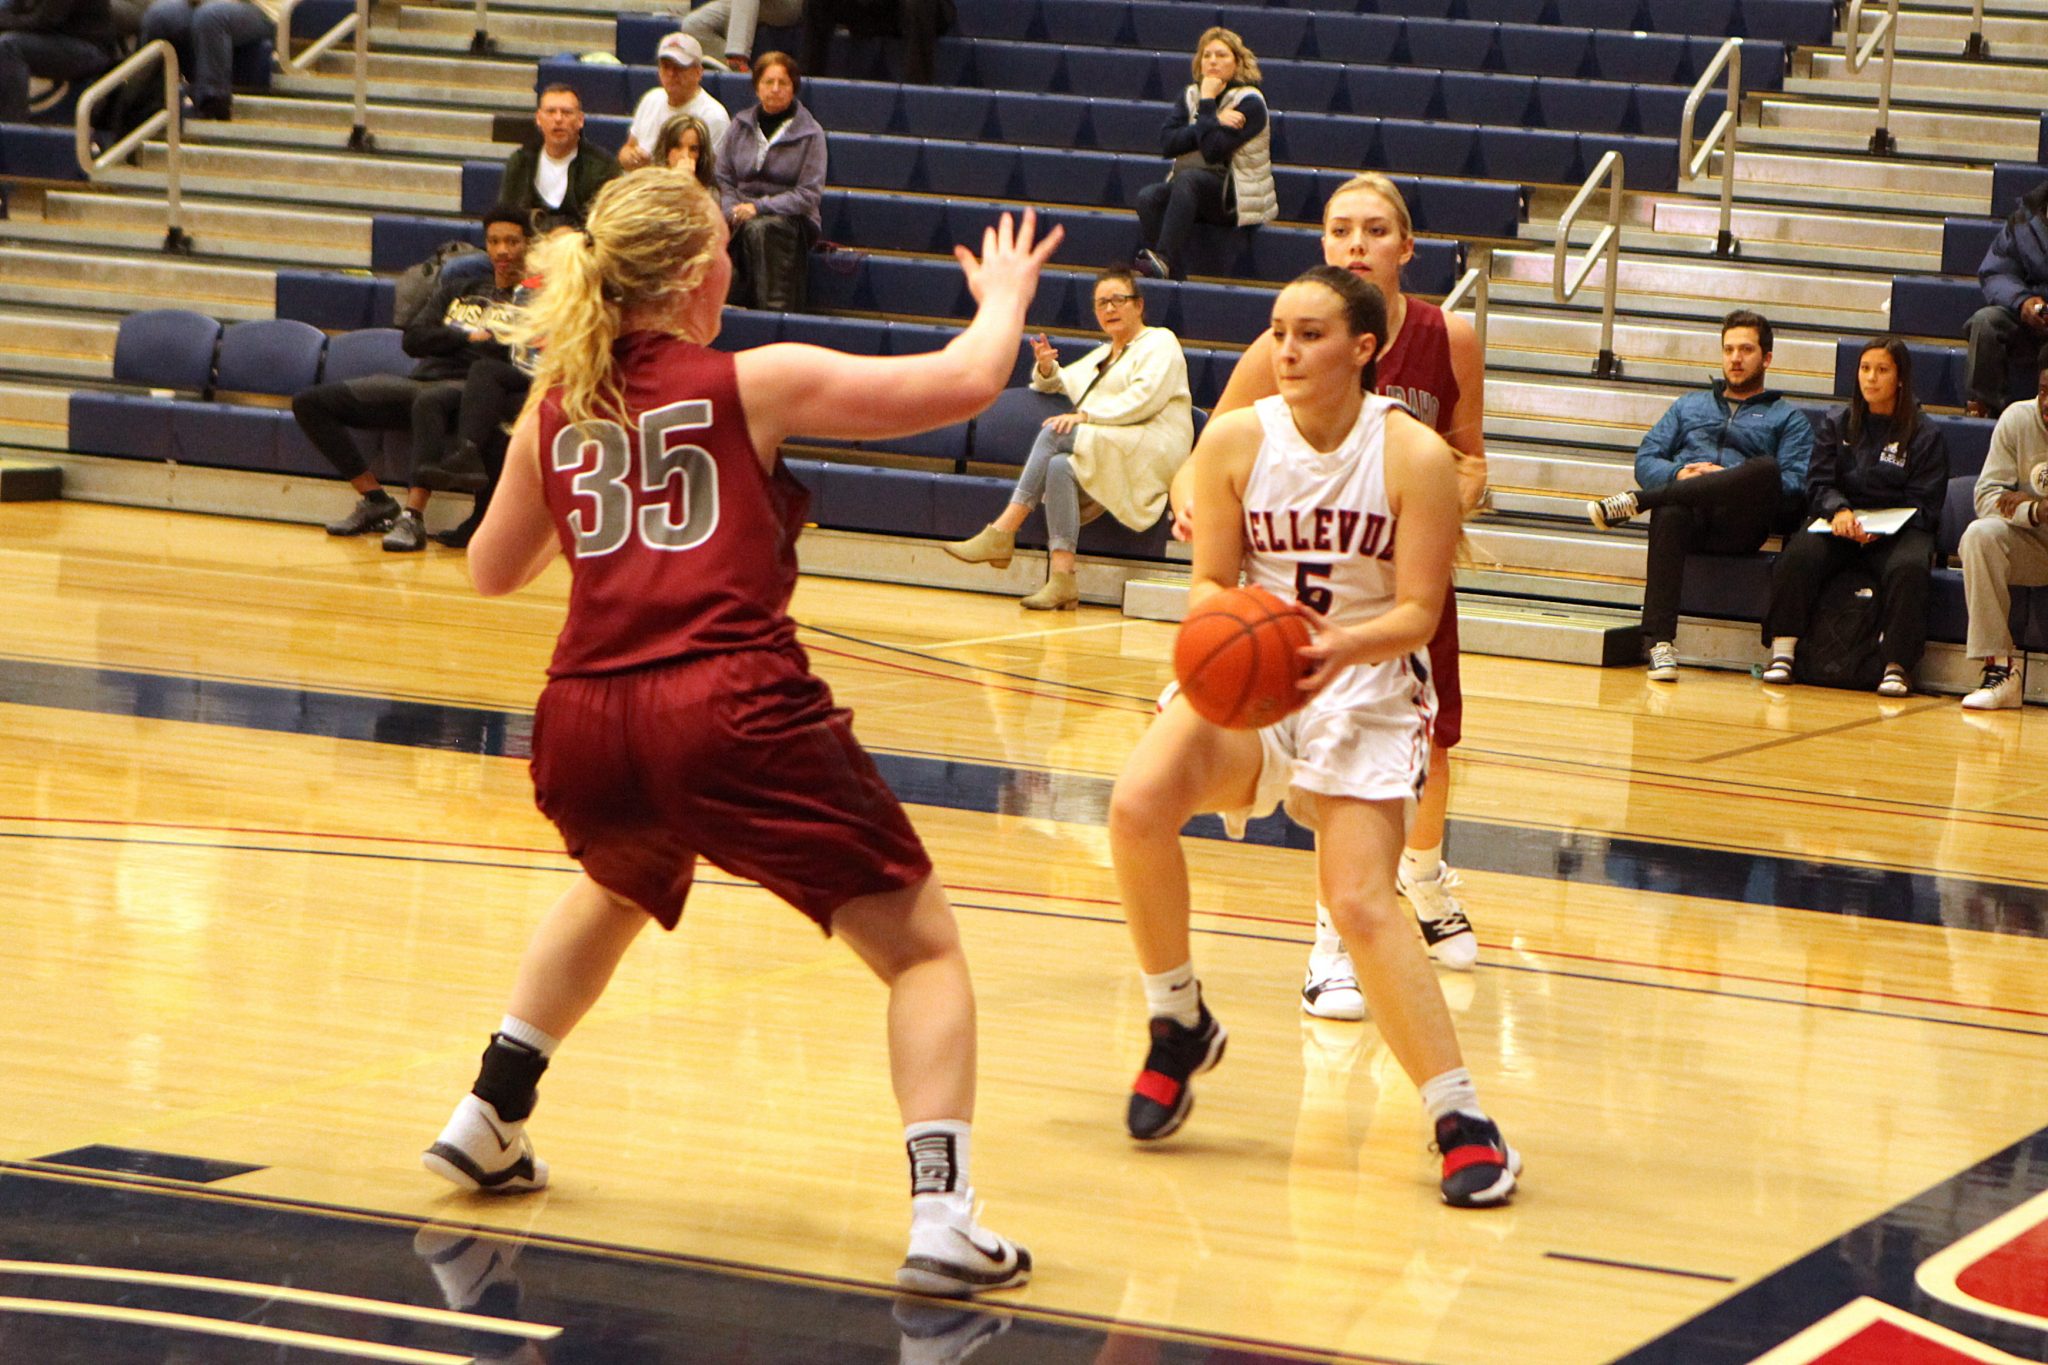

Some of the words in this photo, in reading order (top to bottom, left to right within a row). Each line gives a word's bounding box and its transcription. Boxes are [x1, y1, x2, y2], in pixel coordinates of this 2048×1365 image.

[553, 399, 720, 559] 35
[1248, 507, 1397, 562] ELLEVU
[1295, 561, 1333, 616] 5
